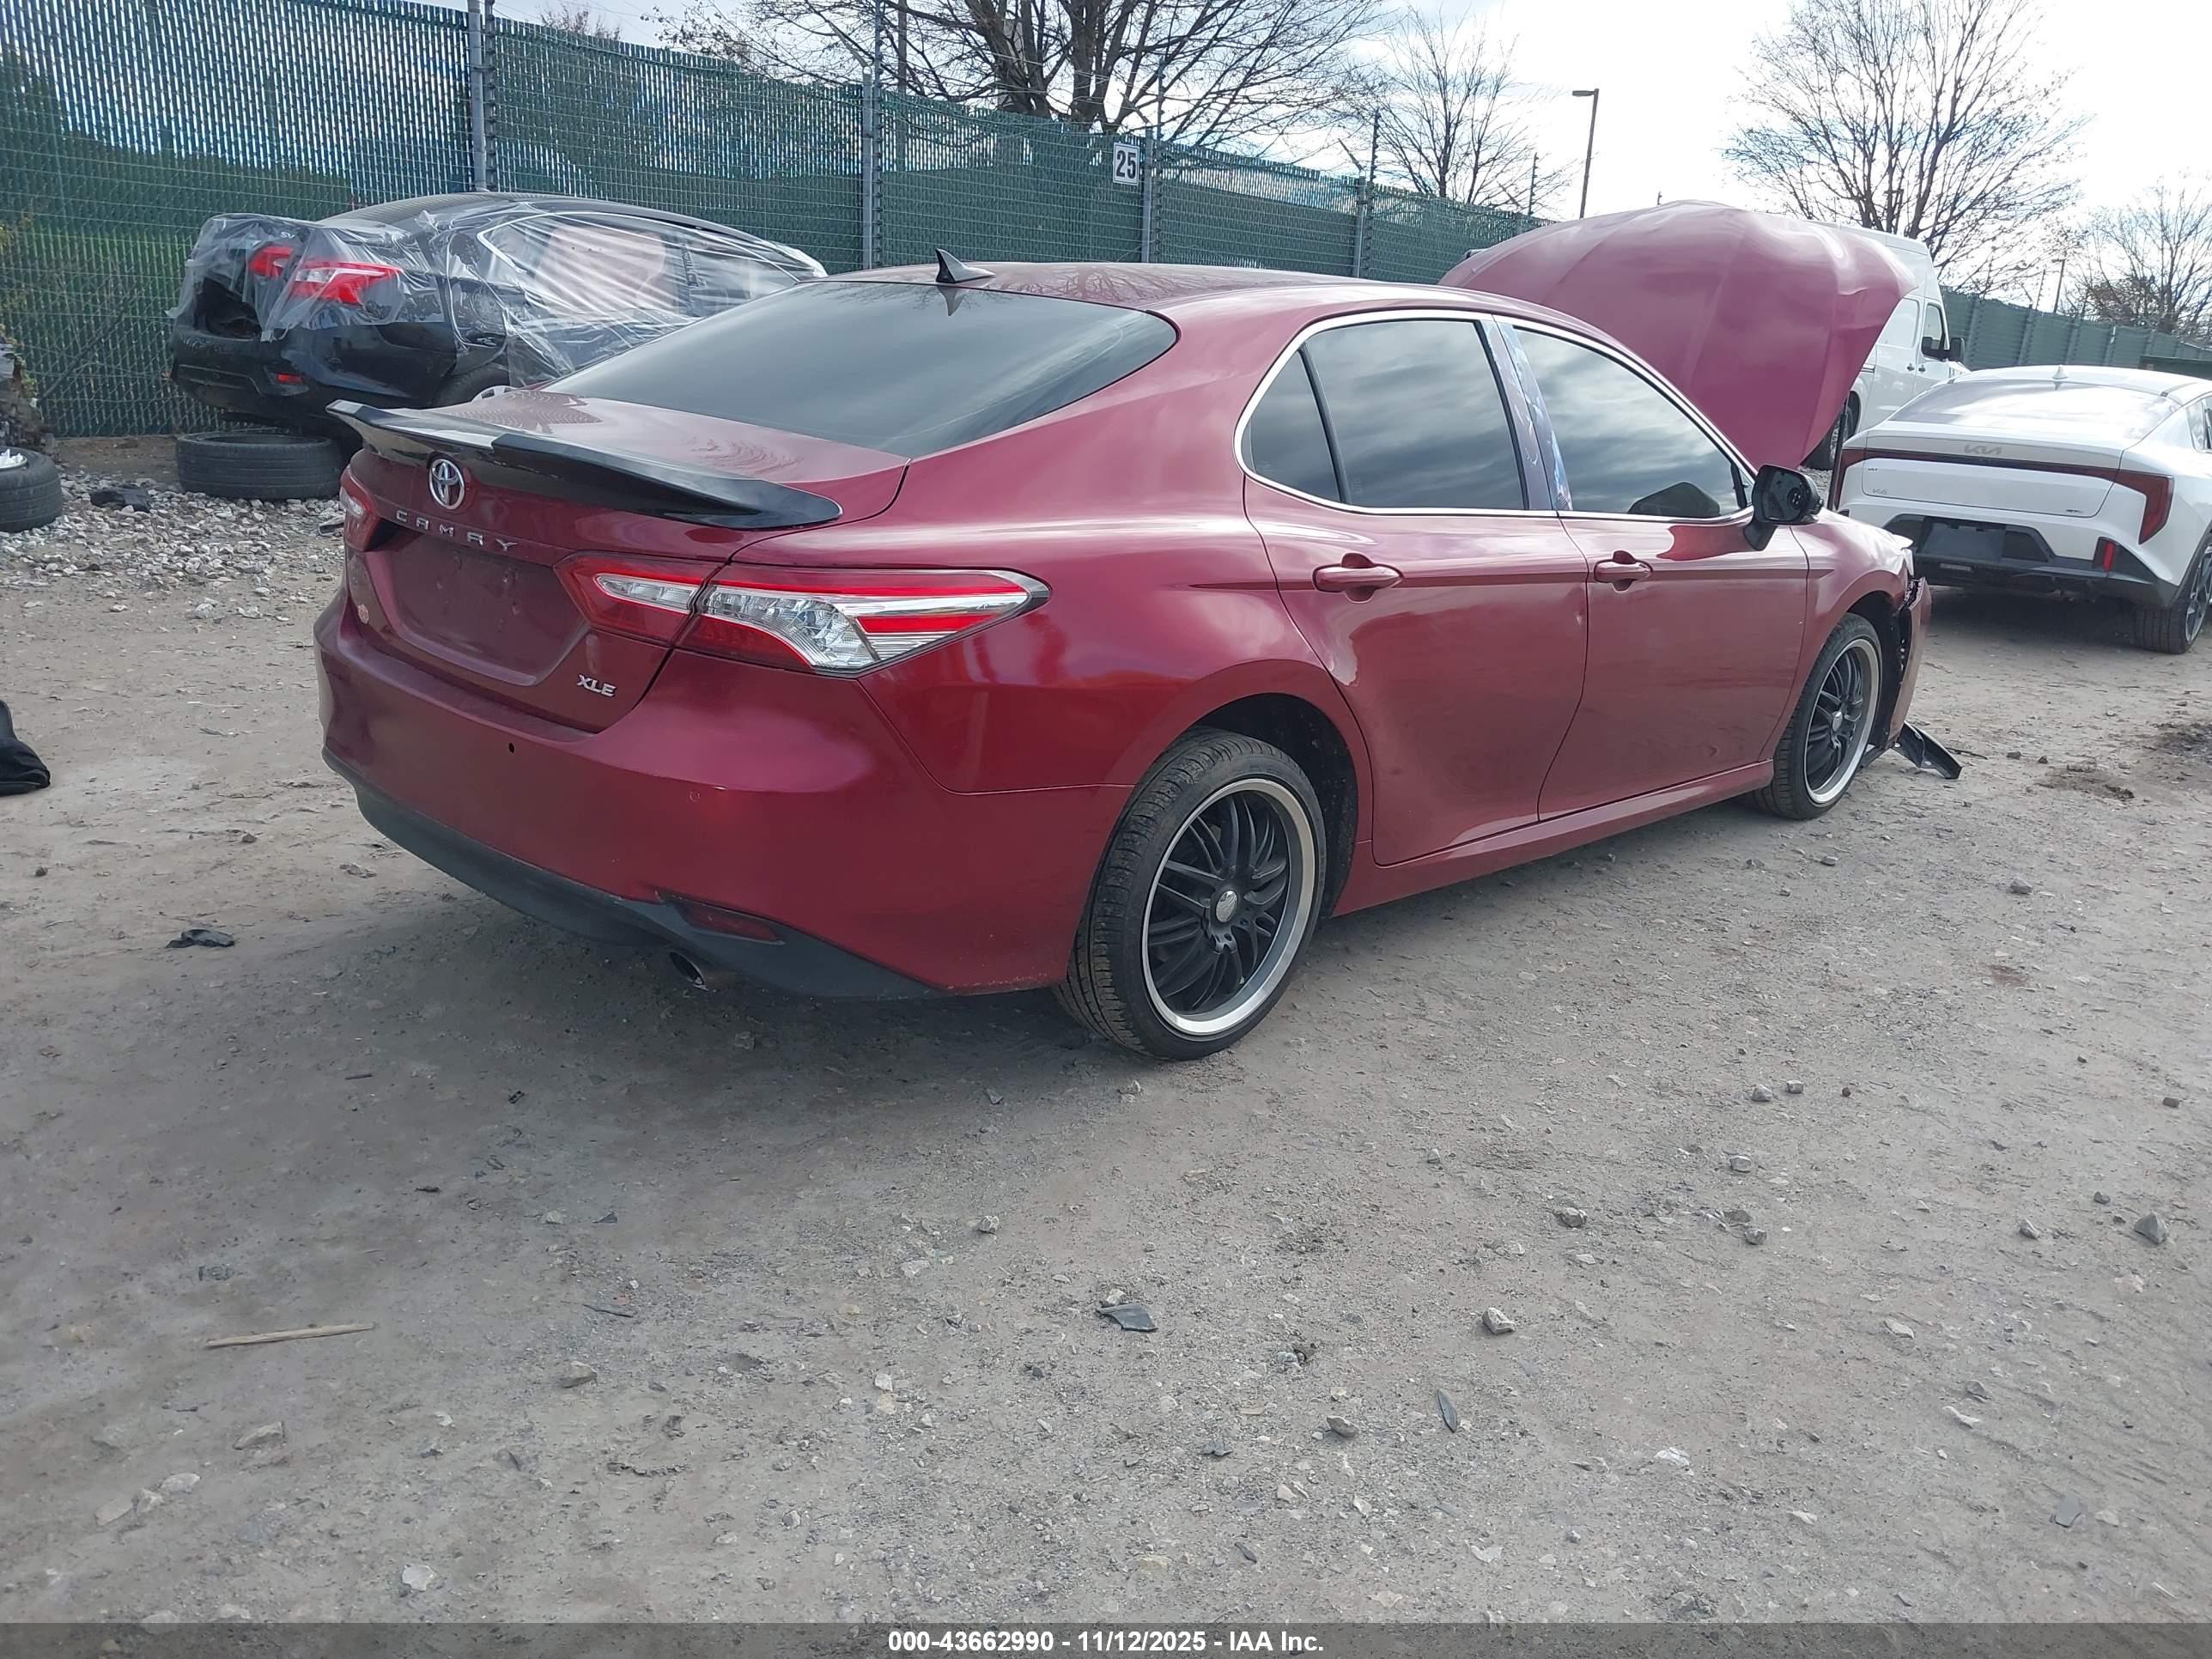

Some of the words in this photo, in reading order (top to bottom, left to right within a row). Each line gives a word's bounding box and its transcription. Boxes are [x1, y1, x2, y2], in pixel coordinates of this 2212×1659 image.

[1116, 149, 1137, 179] 25
[396, 509, 518, 551] CAMRY
[576, 673, 617, 697] XLE
